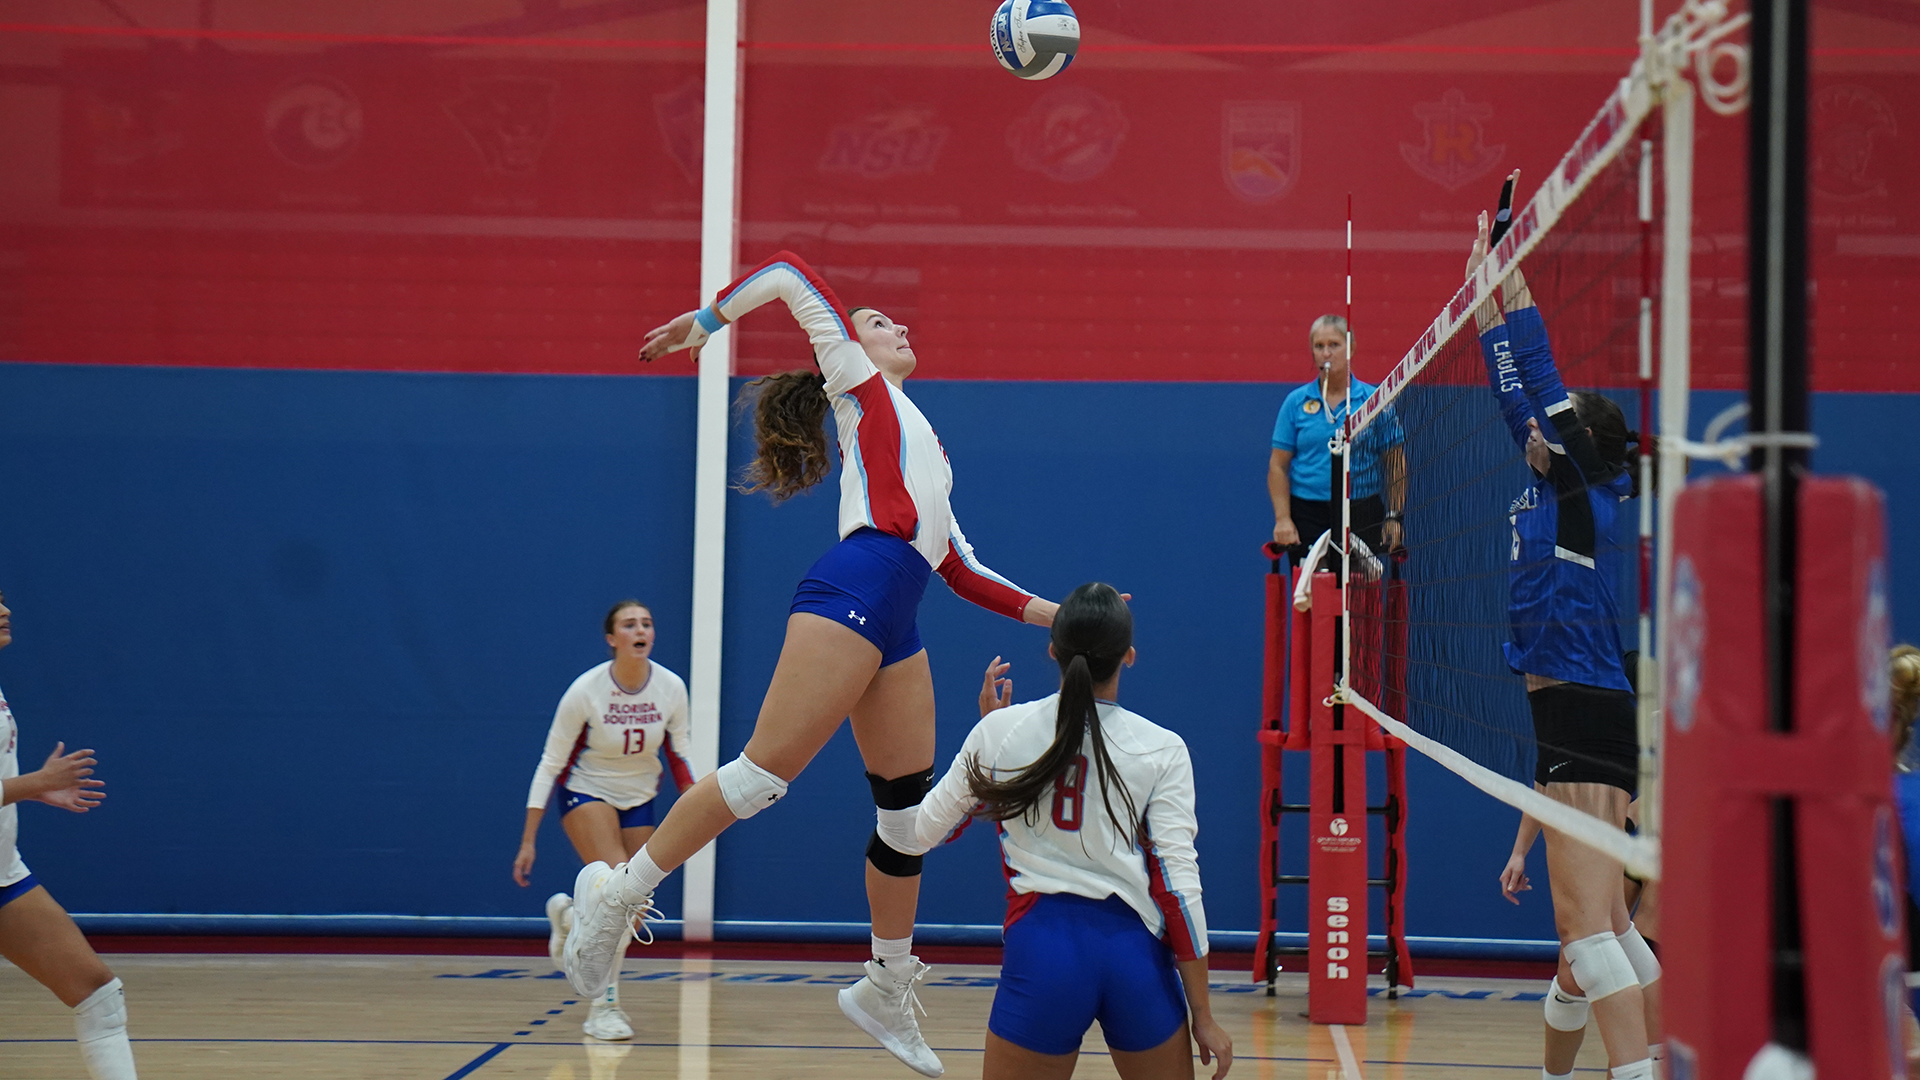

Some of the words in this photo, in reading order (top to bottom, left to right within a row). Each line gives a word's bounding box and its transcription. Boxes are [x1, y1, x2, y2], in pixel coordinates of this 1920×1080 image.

[997, 12, 1014, 52] NCAA
[1016, 30, 1028, 54] Super
[603, 712, 663, 725] SOUTHERN
[608, 702, 657, 714] FLORIDA
[623, 728, 646, 755] 13
[1052, 753, 1090, 833] 8
[1326, 896, 1350, 980] senoh
